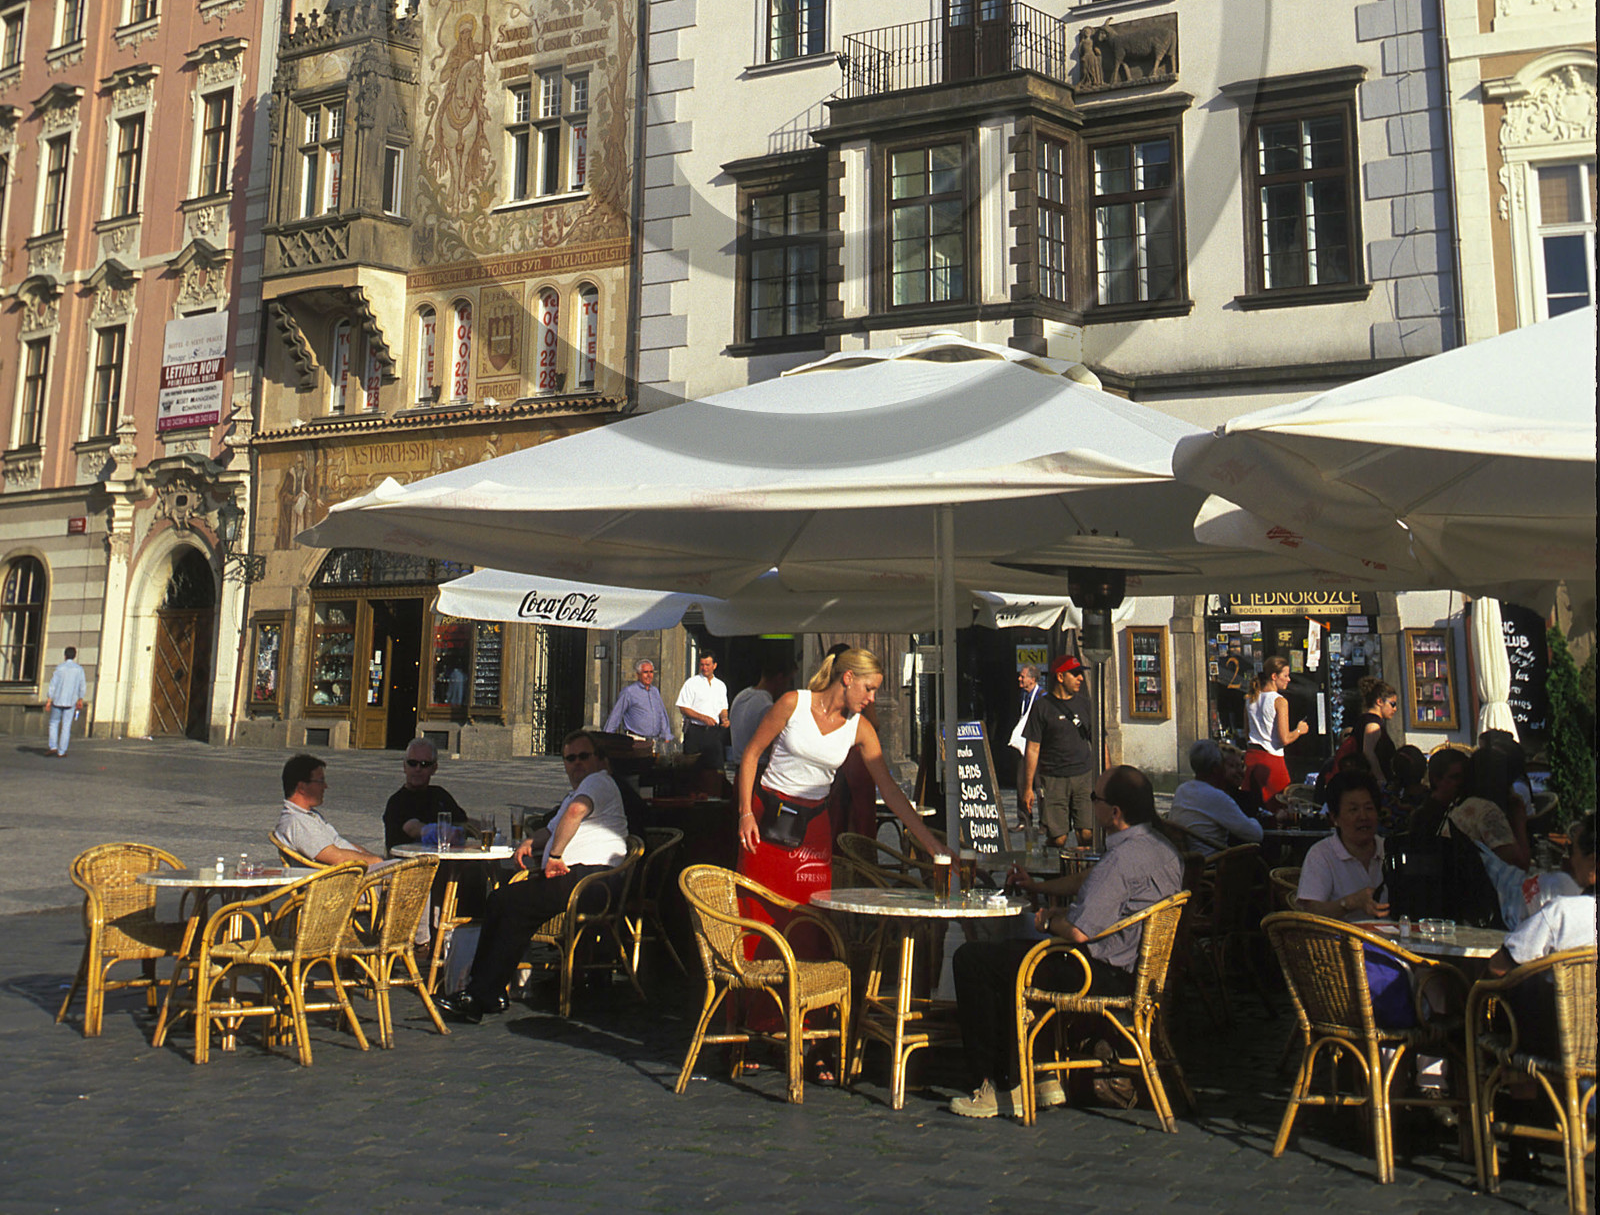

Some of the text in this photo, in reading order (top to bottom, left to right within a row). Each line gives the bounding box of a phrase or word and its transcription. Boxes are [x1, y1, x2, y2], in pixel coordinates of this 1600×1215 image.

[165, 359, 220, 381] LETTING NOW
[517, 590, 600, 623] Coca-Cola
[961, 782, 988, 801] SOUPS
[796, 873, 827, 883] ESPRESSO
